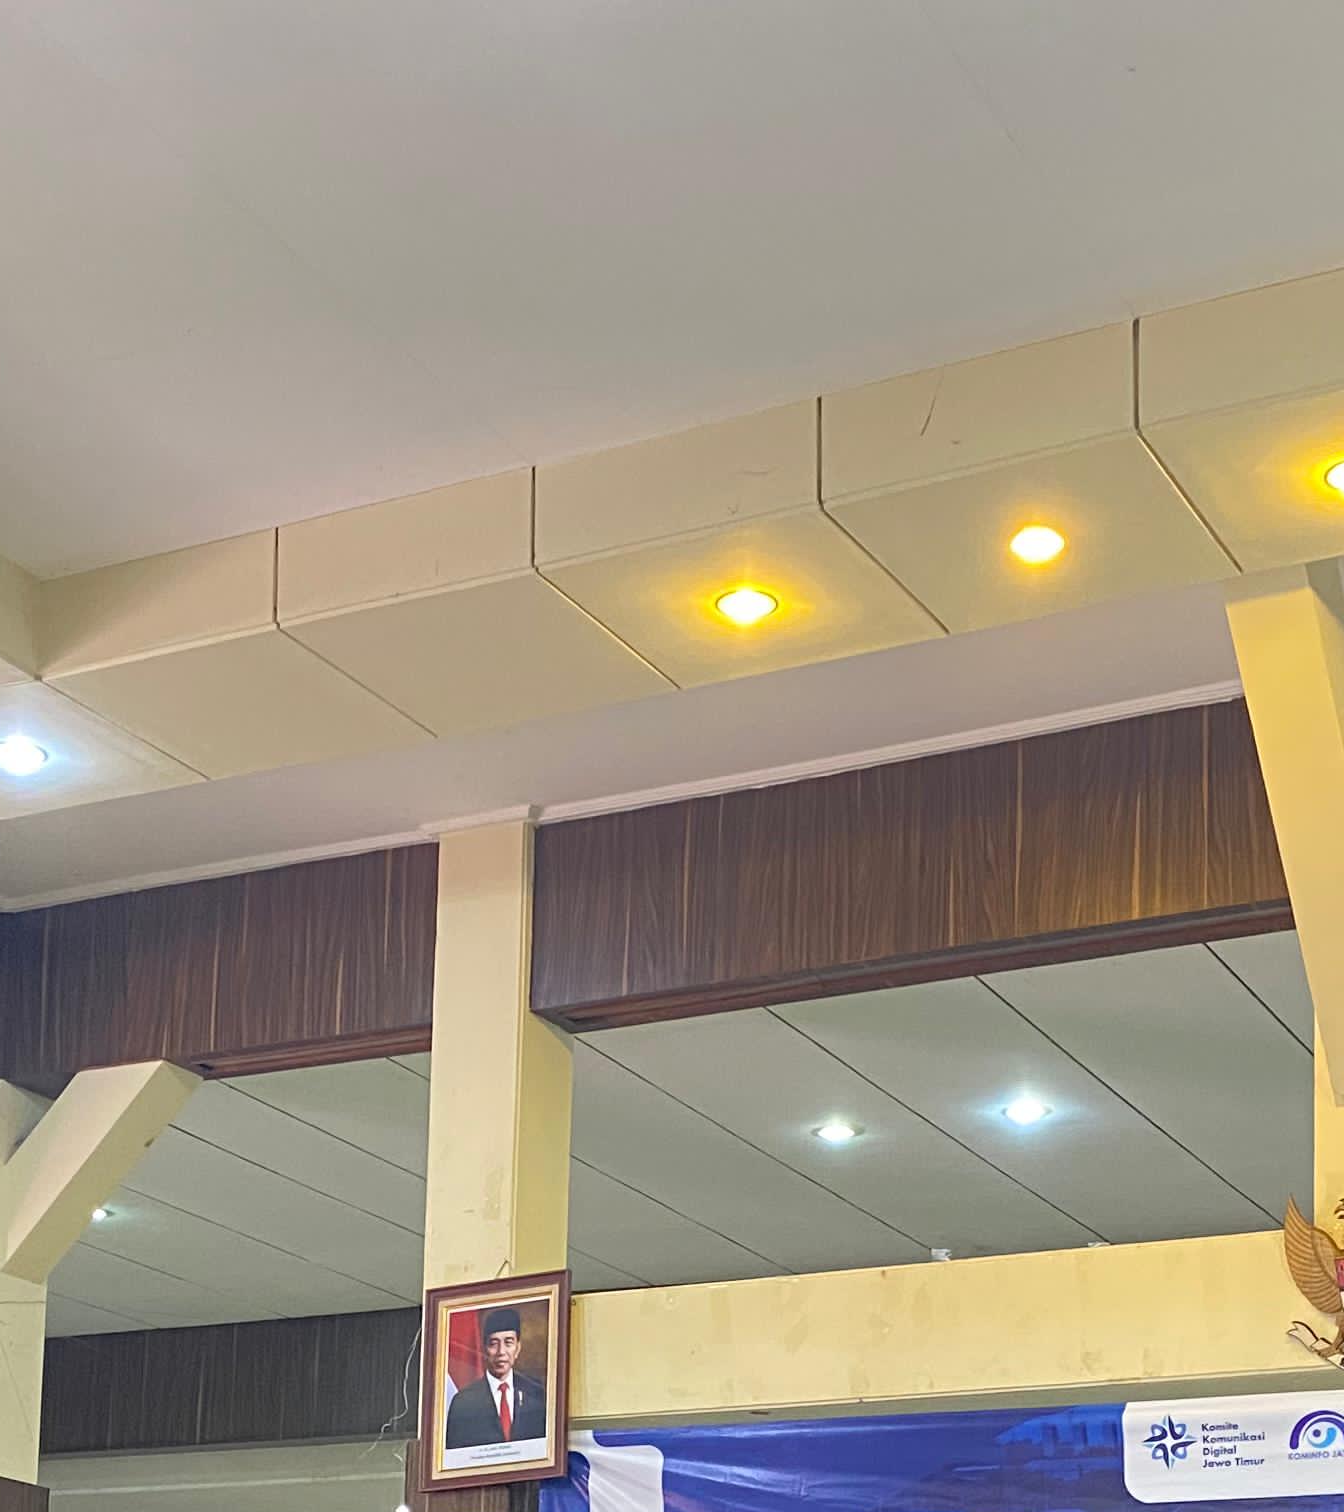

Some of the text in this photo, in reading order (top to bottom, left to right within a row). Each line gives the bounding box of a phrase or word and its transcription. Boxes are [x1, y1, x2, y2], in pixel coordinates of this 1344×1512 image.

[1201, 1422, 1239, 1432] Komite
[1202, 1432, 1266, 1445] Komunikasi
[1202, 1446, 1237, 1458] Digital
[1202, 1456, 1266, 1469] Jawa Timur
